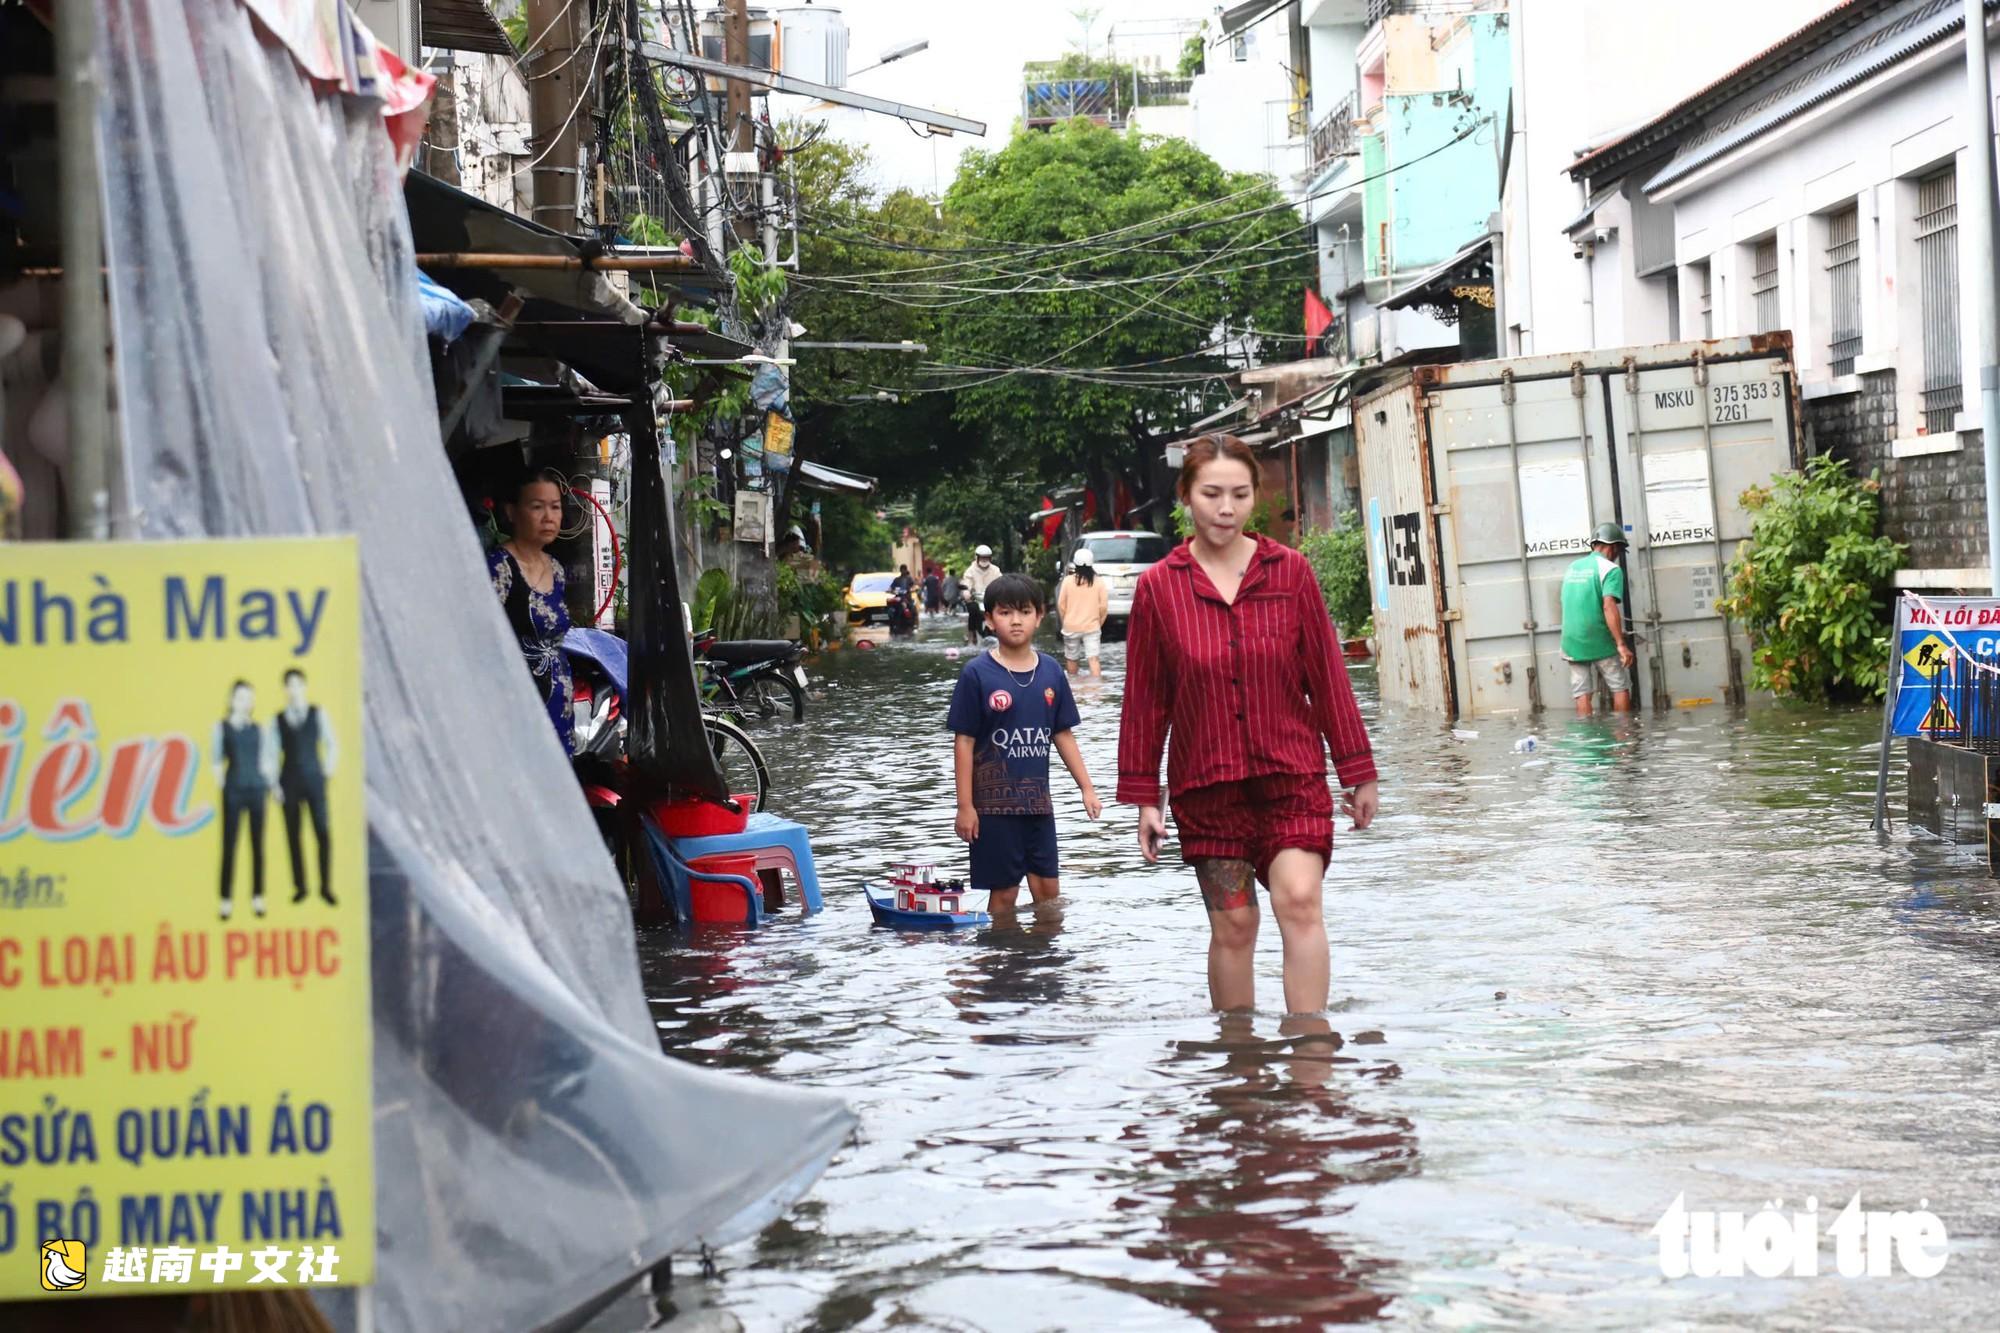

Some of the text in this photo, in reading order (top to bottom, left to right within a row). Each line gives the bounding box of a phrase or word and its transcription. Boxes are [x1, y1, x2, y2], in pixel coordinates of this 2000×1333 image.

[1655, 381, 1781, 409] MSKU 375 353 3
[1715, 404, 1748, 422] 22G1
[1526, 537, 1591, 553] MAERSK
[1650, 527, 1714, 543] MAERSK
[164, 573, 328, 656] May
[992, 727, 1051, 749] QATAR
[38, 933, 134, 997] LOẠI
[152, 921, 208, 983] ÂU
[225, 928, 339, 990] PHỤC
[132, 1011, 196, 1073] NỮ
[1, 1095, 97, 1166] SỬA
[269, 1092, 332, 1155] ÁO
[120, 1194, 222, 1247] MAY
[243, 1176, 342, 1242] NHÀ
